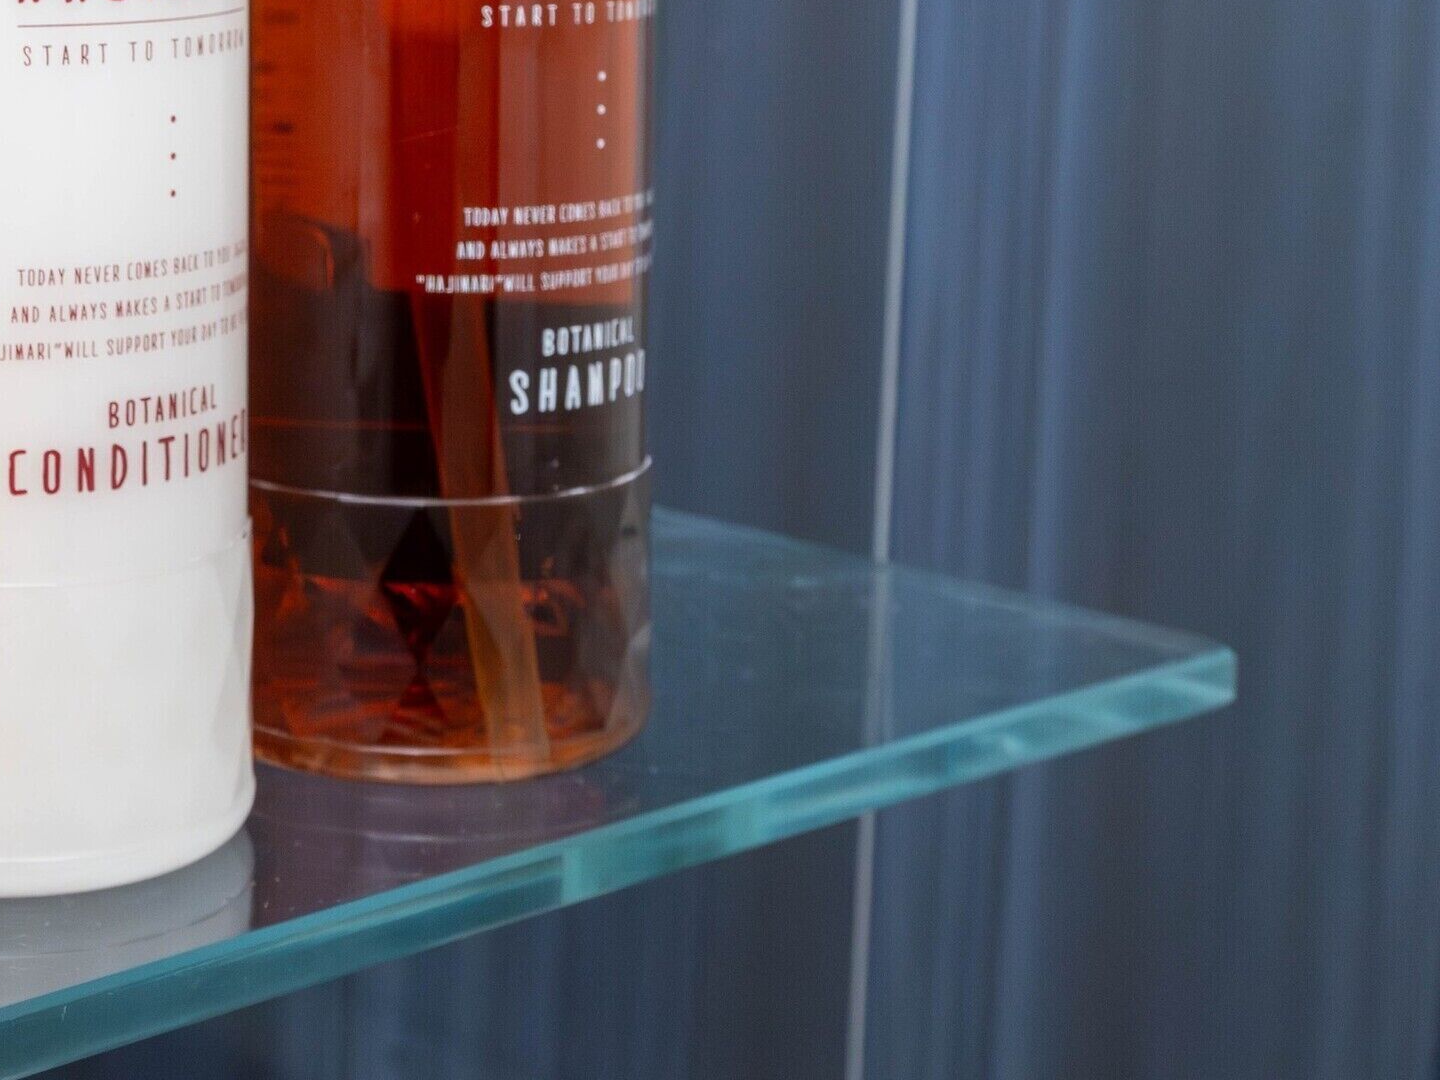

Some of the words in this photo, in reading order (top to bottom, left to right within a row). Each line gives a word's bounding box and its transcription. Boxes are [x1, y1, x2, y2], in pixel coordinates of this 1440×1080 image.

[480, 3, 558, 28] START
[572, 1, 595, 25] TO
[22, 42, 108, 67] START
[128, 39, 153, 63] TO
[463, 206, 509, 227] TODAY
[513, 204, 556, 226] NEVER
[456, 240, 485, 261] AND
[490, 238, 544, 260] ALWAYS
[17, 268, 65, 287] TODAY
[74, 264, 120, 286] NEVER
[127, 258, 168, 281] COMES
[173, 253, 198, 275] BACK
[11, 306, 40, 324] AND
[49, 301, 107, 323] ALWAYS
[115, 296, 158, 318] MAKES
[106, 331, 165, 357] SUPPORT
[109, 383, 217, 429] BOTANICAL
